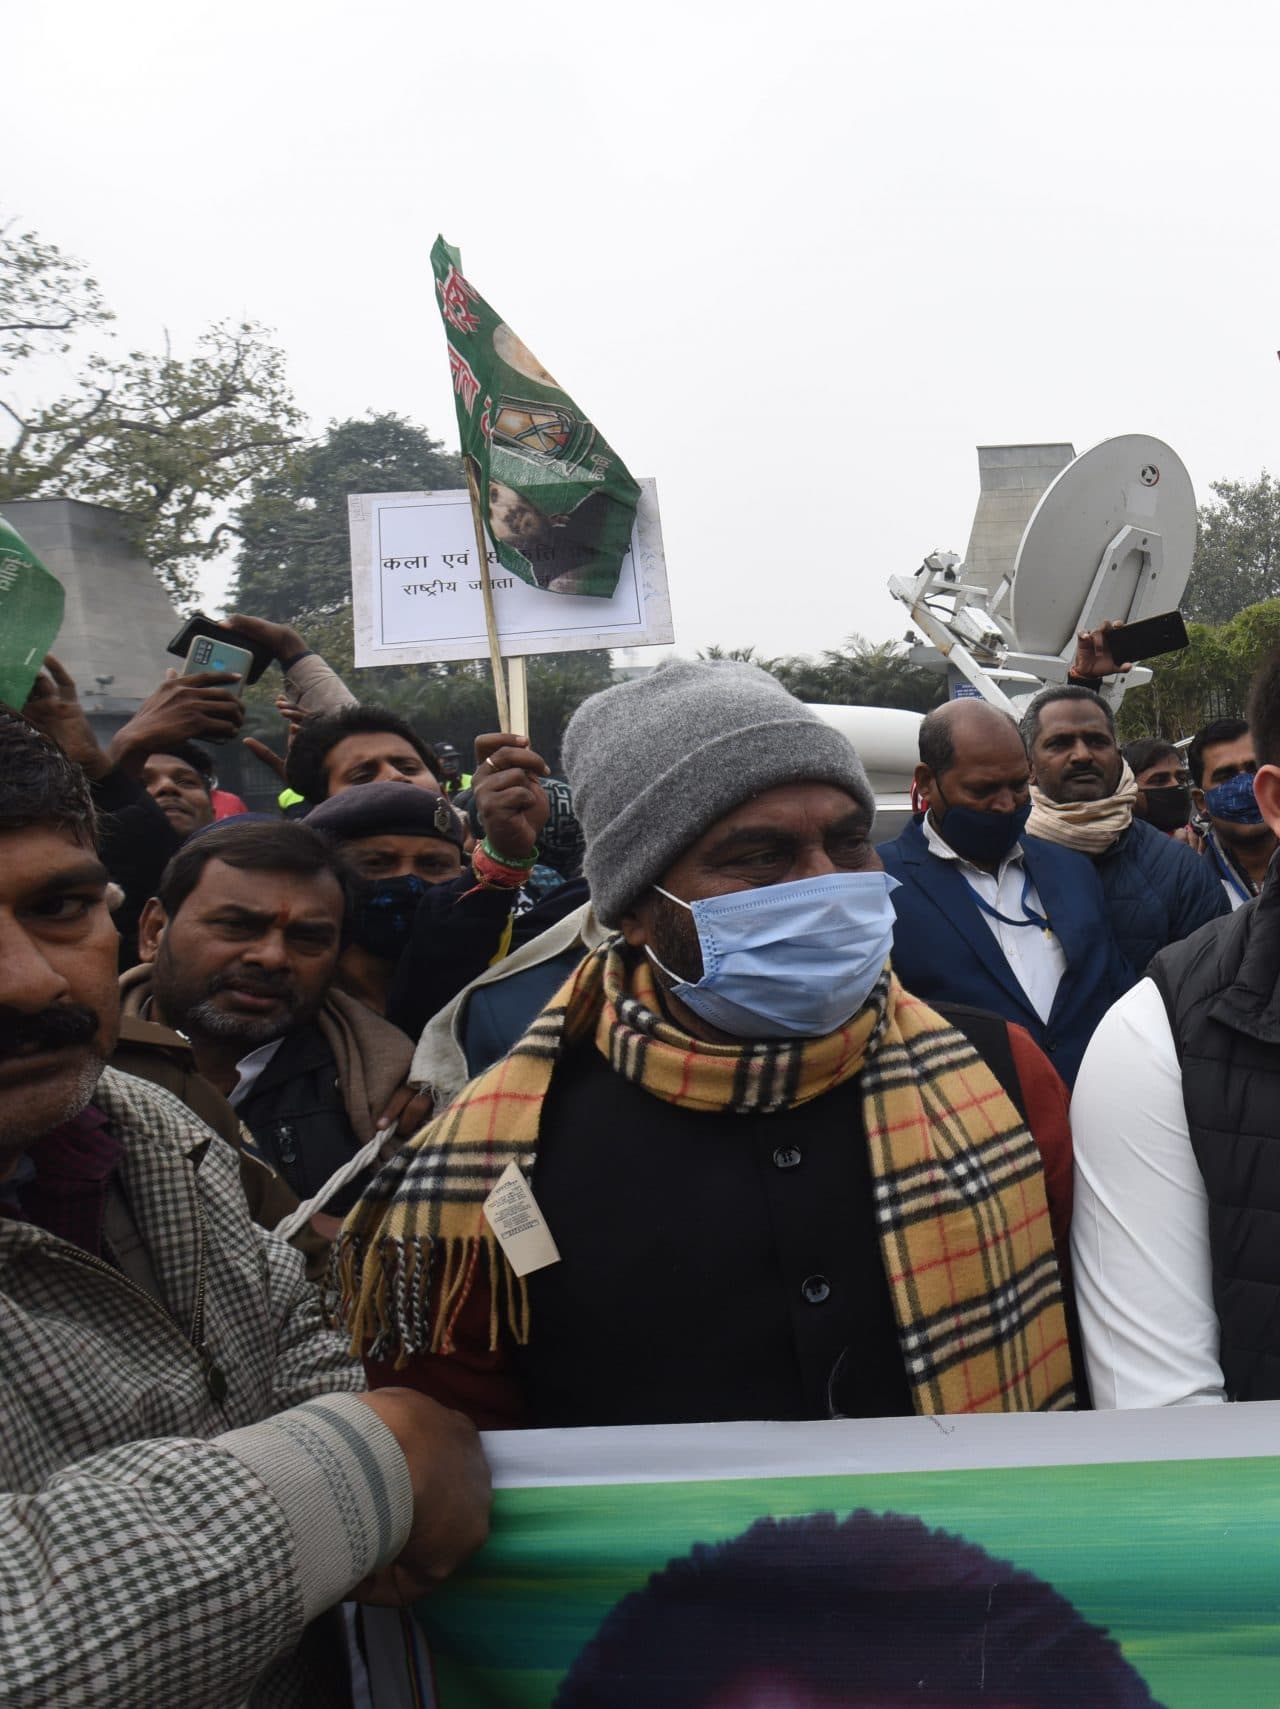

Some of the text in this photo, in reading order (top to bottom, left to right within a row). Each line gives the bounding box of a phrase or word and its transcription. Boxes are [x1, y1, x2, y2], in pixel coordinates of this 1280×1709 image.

[381, 555, 429, 570] कला
[441, 549, 470, 568] एवं
[401, 579, 459, 597] राष्ट्रीय
